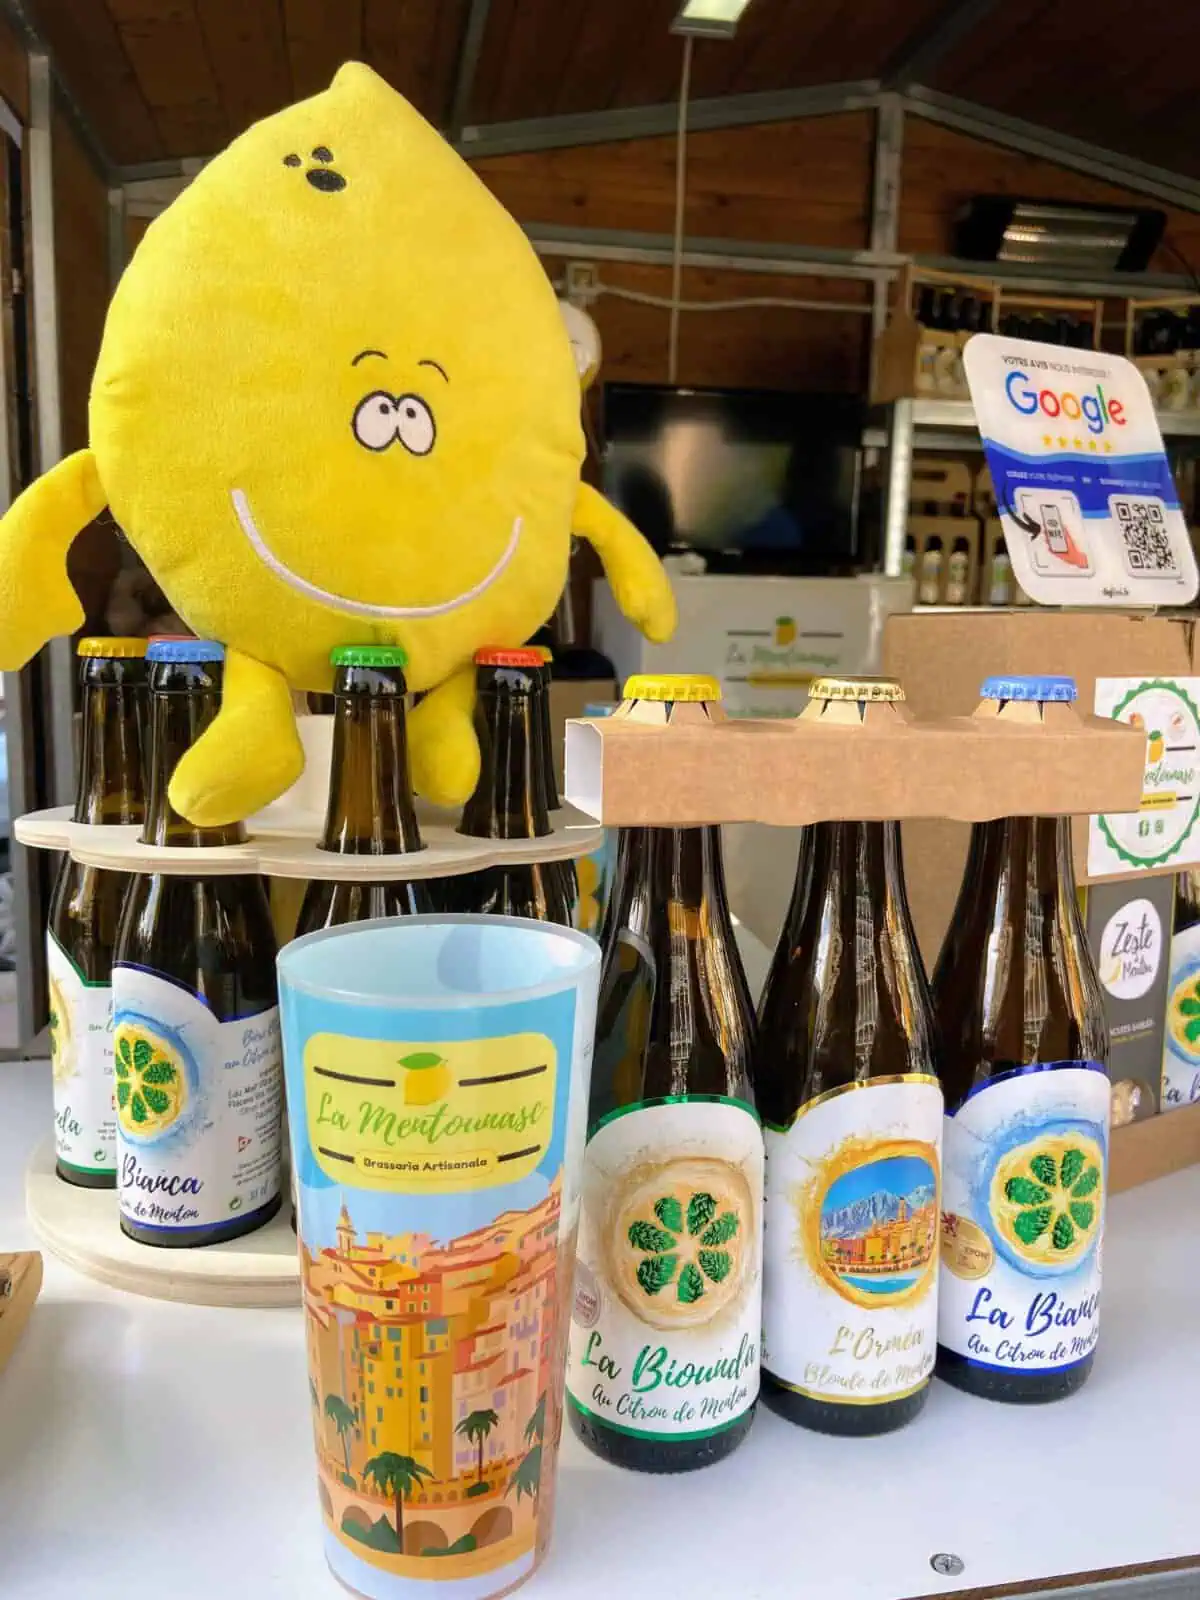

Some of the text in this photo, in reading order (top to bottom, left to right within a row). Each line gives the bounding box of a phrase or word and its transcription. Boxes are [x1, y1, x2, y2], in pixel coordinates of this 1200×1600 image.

[1005, 371, 1127, 434] Google
[1111, 913, 1153, 956] Zeste
[316, 1091, 350, 1132] La
[122, 1152, 204, 1197] Bianca
[148, 1202, 200, 1223] Menton
[965, 1287, 1015, 1329] La
[581, 1330, 756, 1393] La Biounda
[967, 1333, 991, 1354] Au
[995, 1339, 1047, 1362] Citron
[1049, 1341, 1066, 1361] de
[616, 1393, 668, 1420] Citron
[673, 1402, 696, 1423] de
[700, 1385, 748, 1419] Menton
